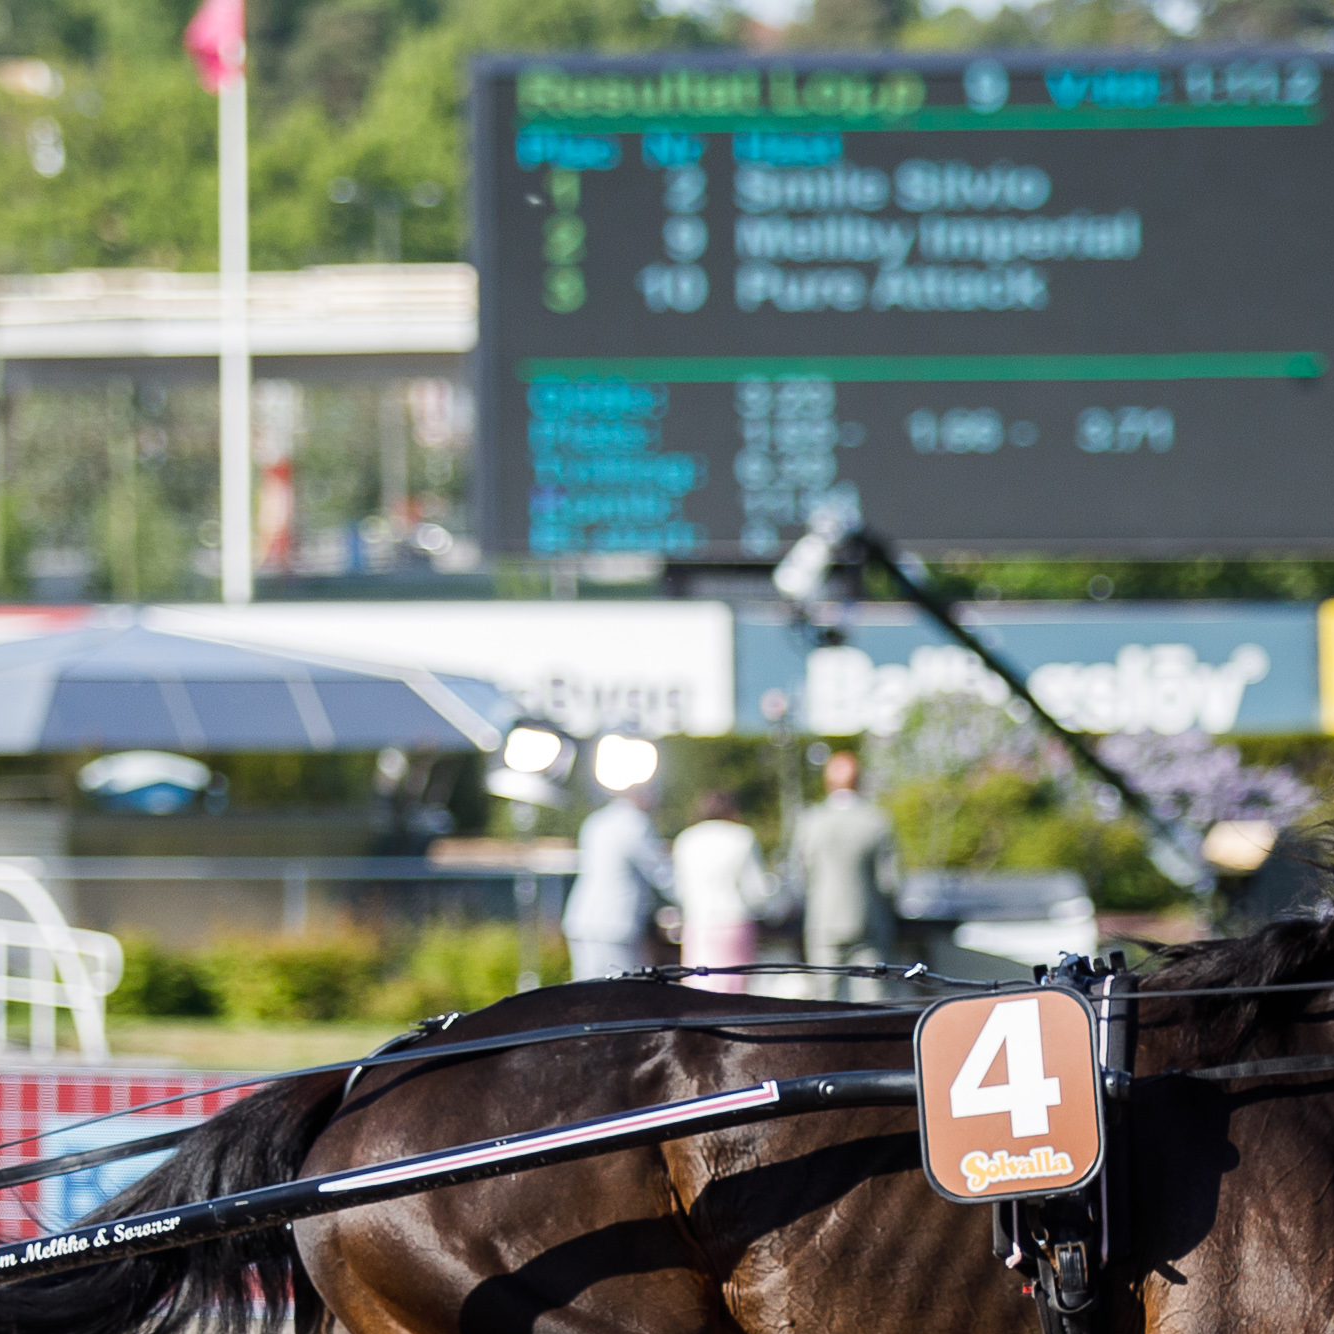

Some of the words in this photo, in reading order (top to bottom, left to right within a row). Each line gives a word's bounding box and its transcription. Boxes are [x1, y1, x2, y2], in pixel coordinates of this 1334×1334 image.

[737, 265, 866, 310] Pure
[873, 264, 1049, 309] Attack
[949, 997, 1062, 1139] 4
[961, 1147, 1073, 1192] Solvalla
[21, 1233, 90, 1264] Melkko
[92, 1227, 111, 1248] &
